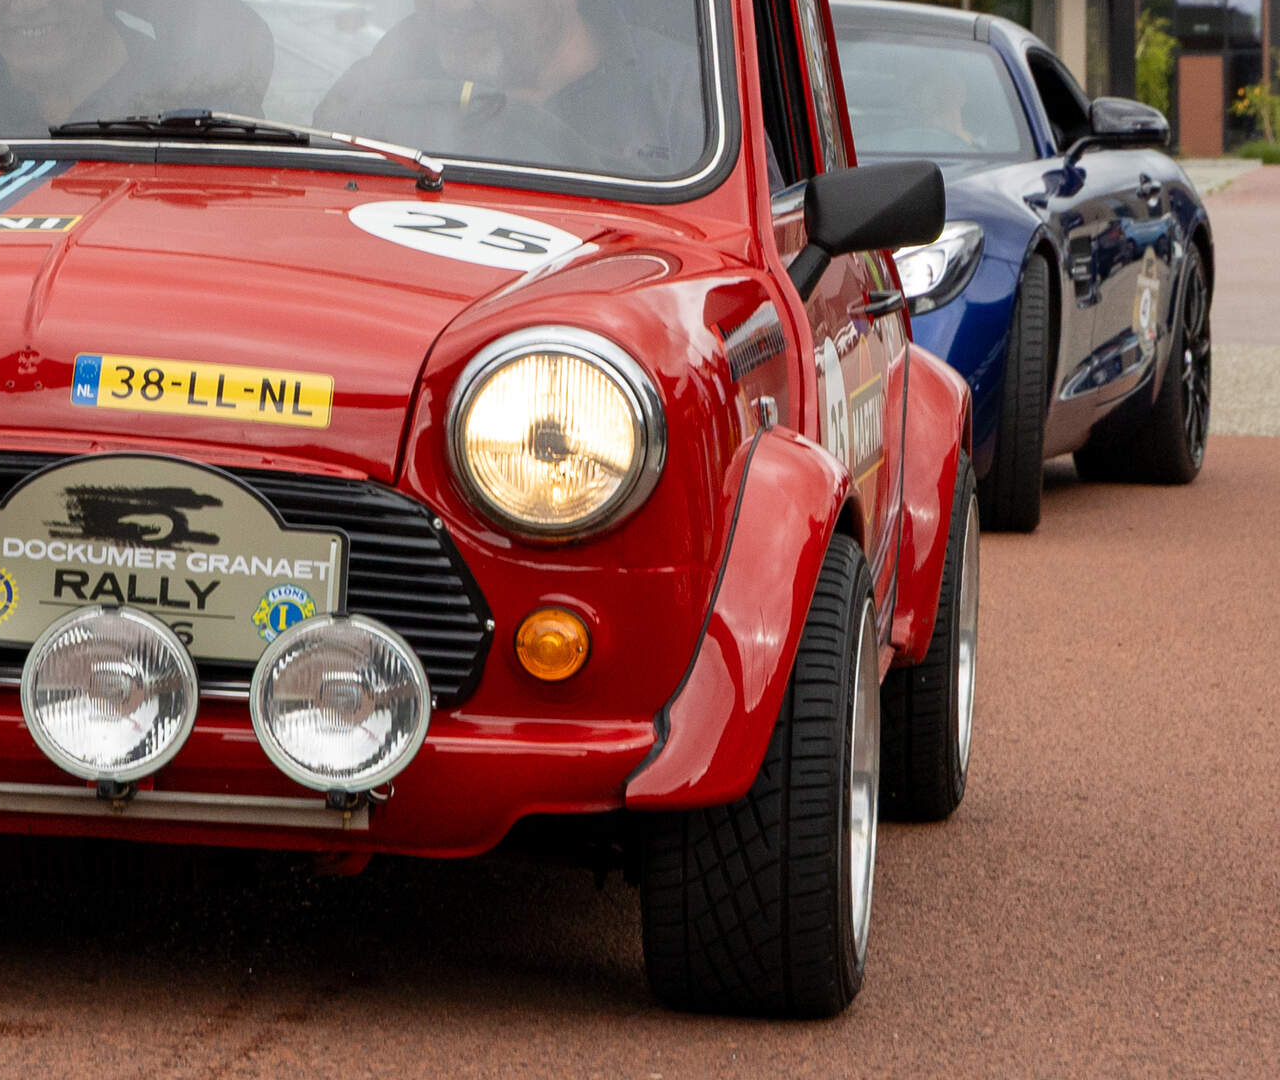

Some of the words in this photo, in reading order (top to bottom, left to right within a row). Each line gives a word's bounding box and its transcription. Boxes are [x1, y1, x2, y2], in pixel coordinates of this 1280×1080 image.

[393, 211, 551, 254] 25
[77, 383, 94, 398] NL
[111, 365, 313, 417] 38-LL-NL
[2, 537, 176, 571] DOCKUMER
[186, 552, 332, 581] GRANAET
[53, 568, 222, 610] RALLY
[272, 588, 304, 601] LIONS
